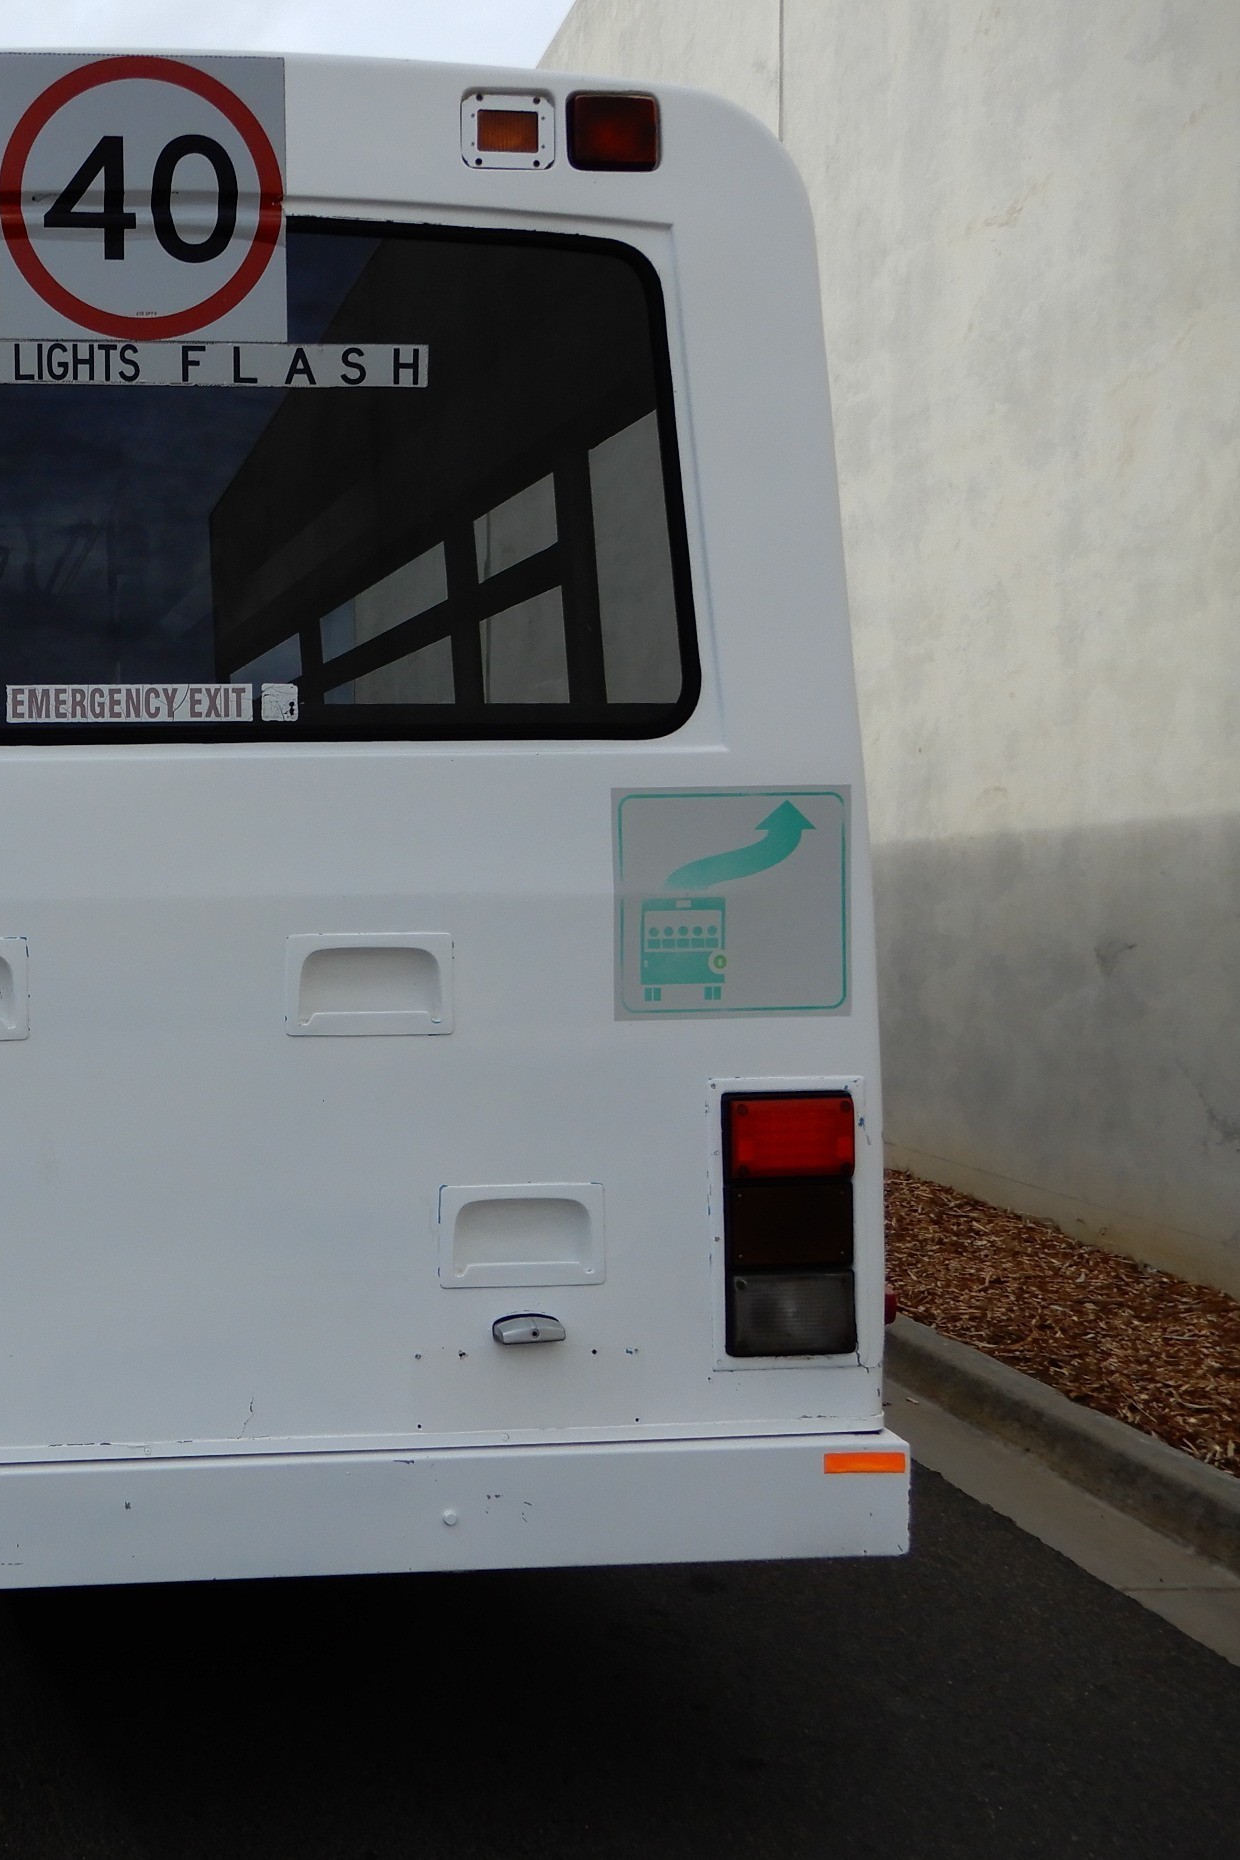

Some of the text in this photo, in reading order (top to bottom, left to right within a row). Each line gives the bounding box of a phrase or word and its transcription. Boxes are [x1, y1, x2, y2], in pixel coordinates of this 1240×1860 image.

[43, 133, 238, 263] 40
[14, 344, 140, 383] LIGHTS
[181, 345, 420, 387] FLASH
[11, 687, 246, 719] EMERGENCY EXIT
